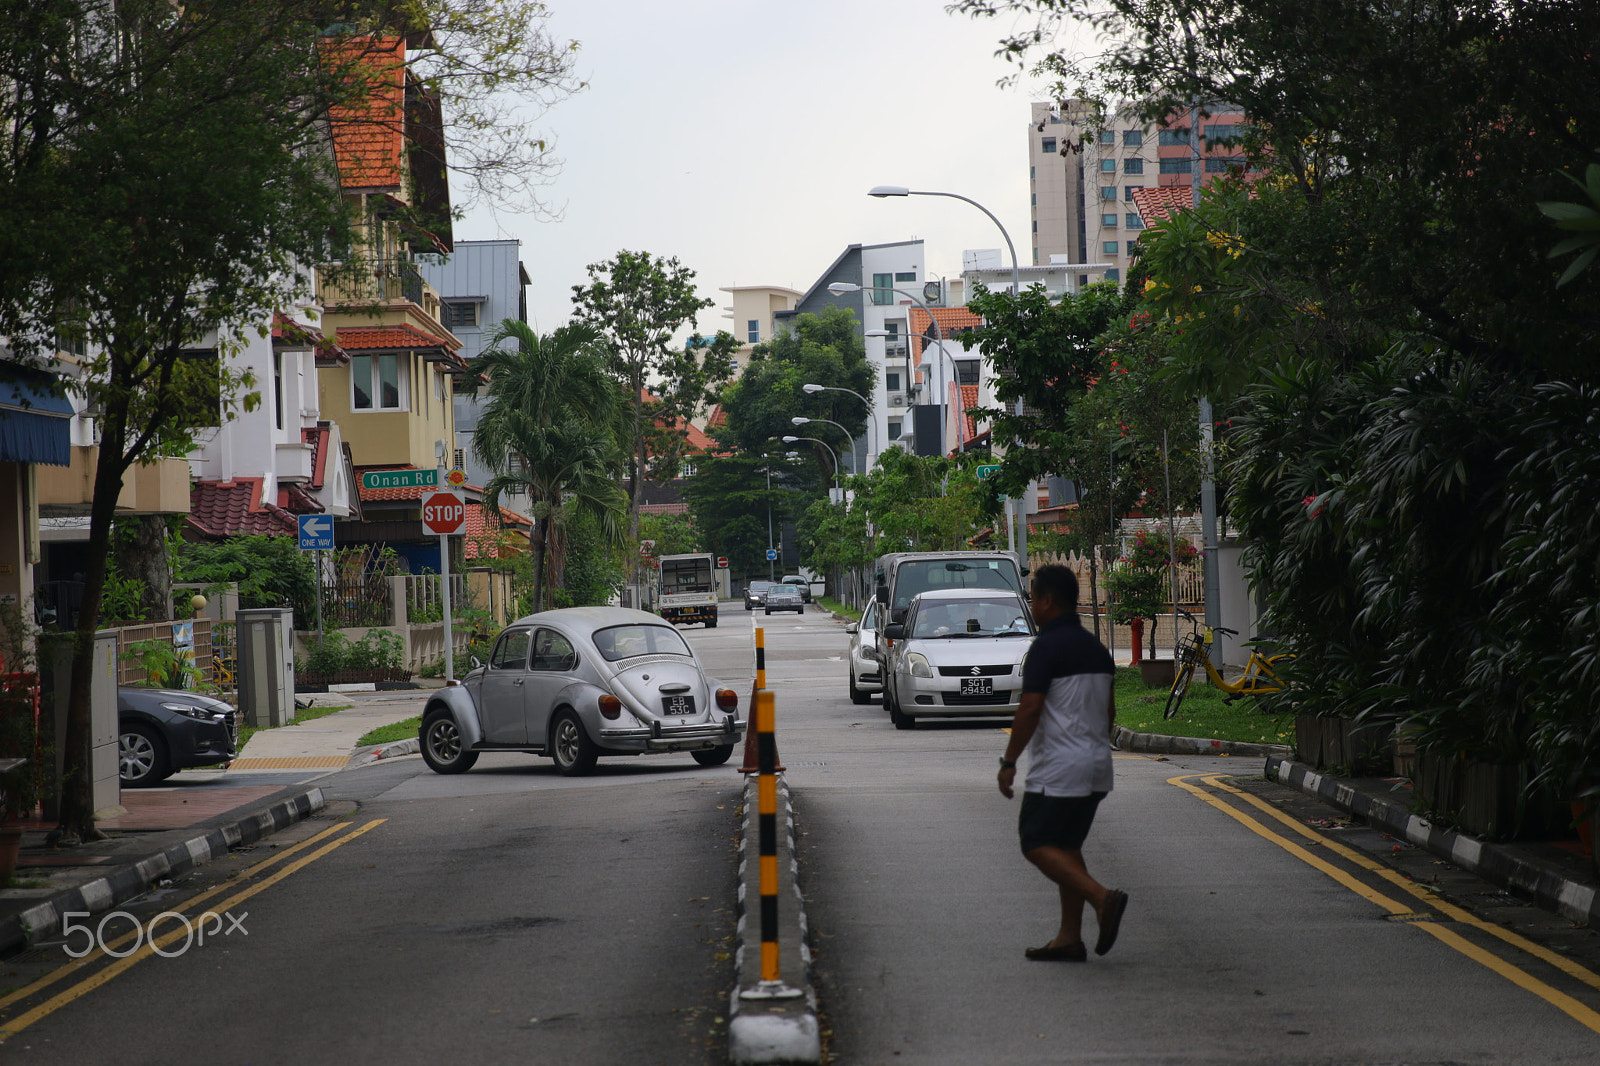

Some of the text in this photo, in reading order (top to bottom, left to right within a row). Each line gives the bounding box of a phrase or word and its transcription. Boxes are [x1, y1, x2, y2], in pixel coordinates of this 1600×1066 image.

[370, 472, 433, 486] Onan Rd
[425, 505, 463, 522] STOP
[301, 538, 331, 547] ONE WAY
[962, 686, 991, 694] 2943C
[672, 697, 685, 705] EB
[670, 705, 689, 714] 53C
